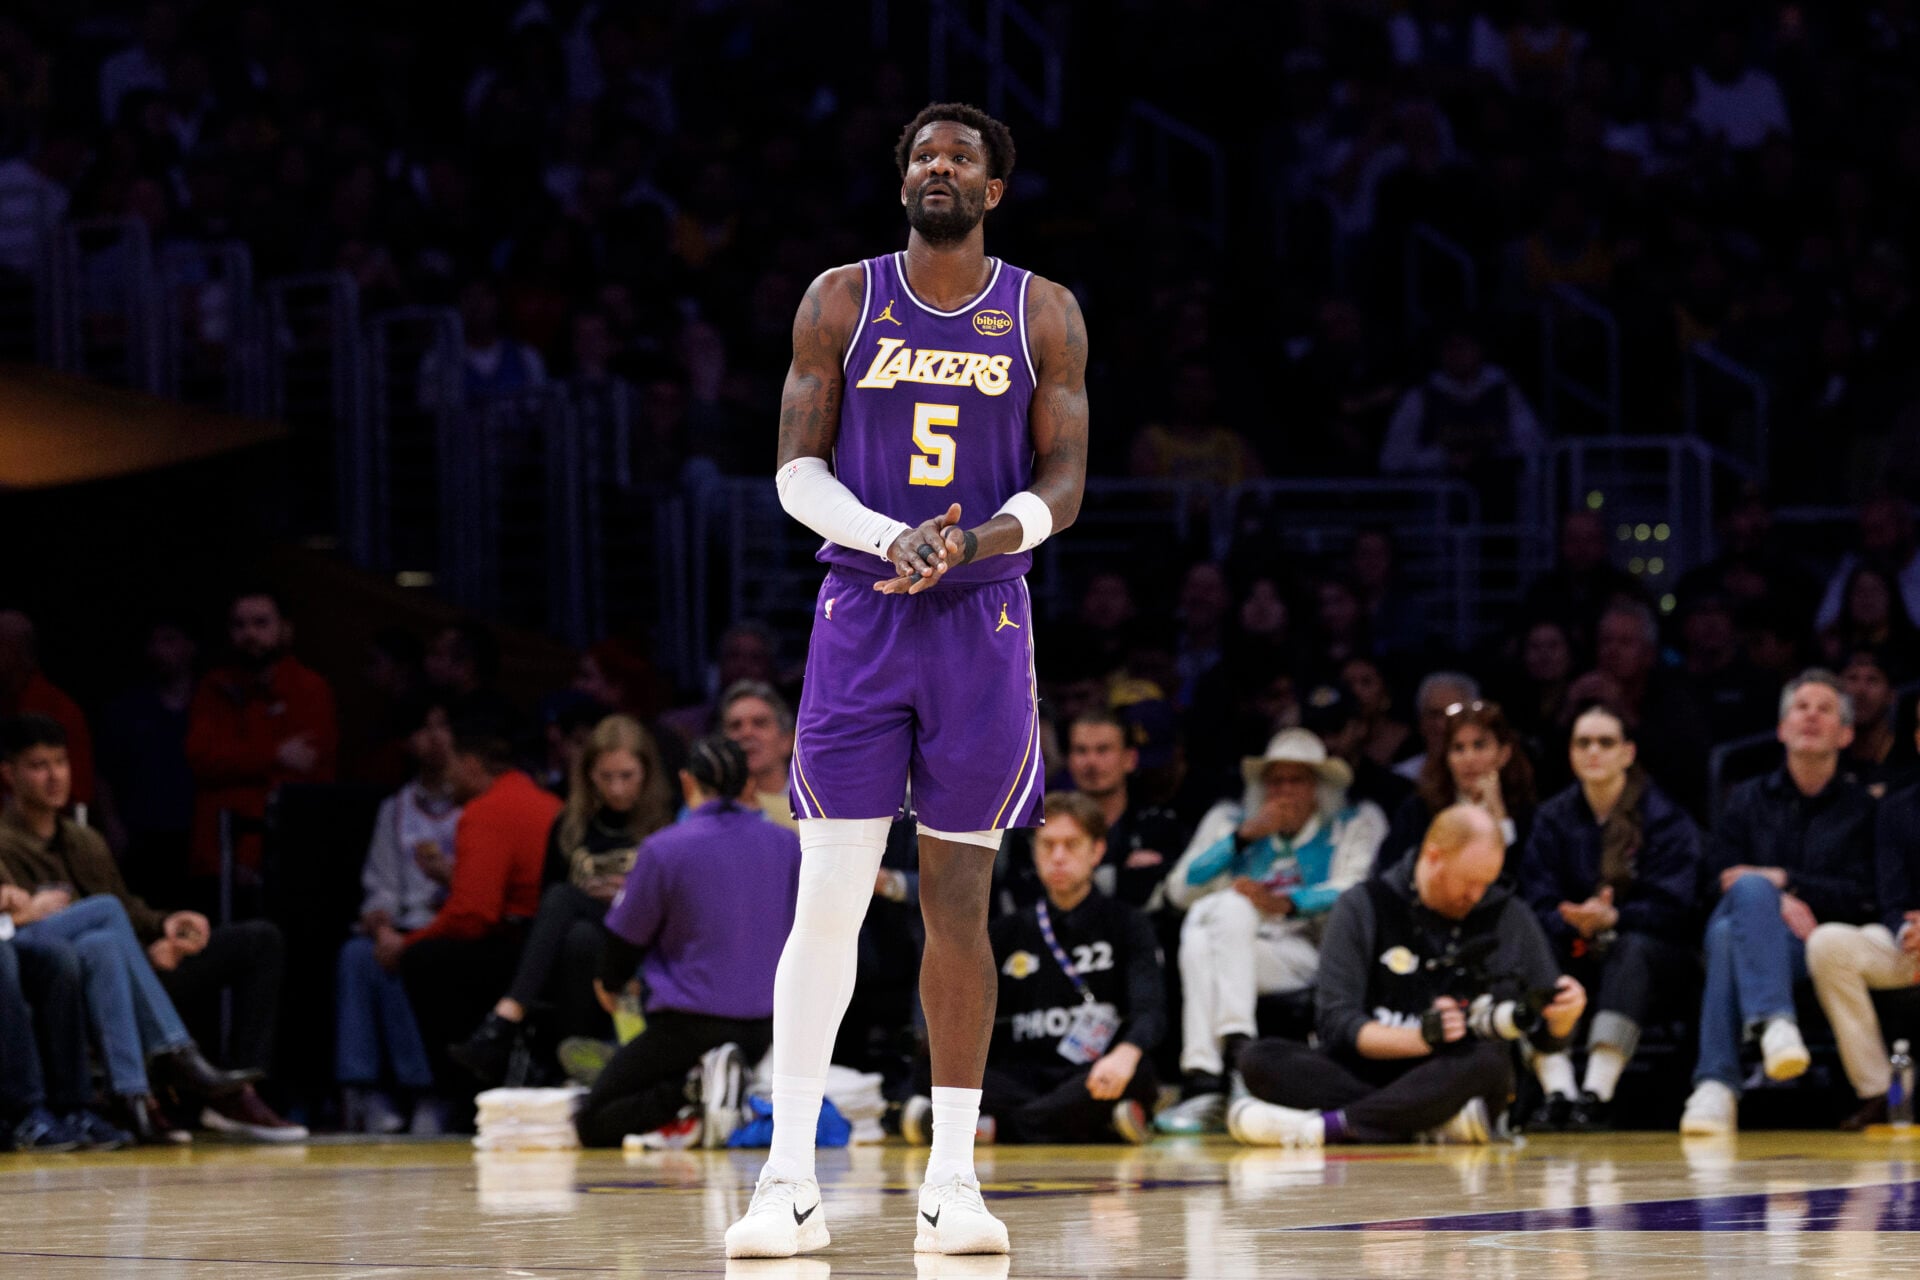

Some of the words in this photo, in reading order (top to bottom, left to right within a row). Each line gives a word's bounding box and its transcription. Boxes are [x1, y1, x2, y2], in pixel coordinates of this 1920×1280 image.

[976, 315, 1010, 329] bibigo
[856, 337, 1013, 396] LAKERS
[909, 402, 960, 487] 5
[1071, 940, 1115, 974] 22
